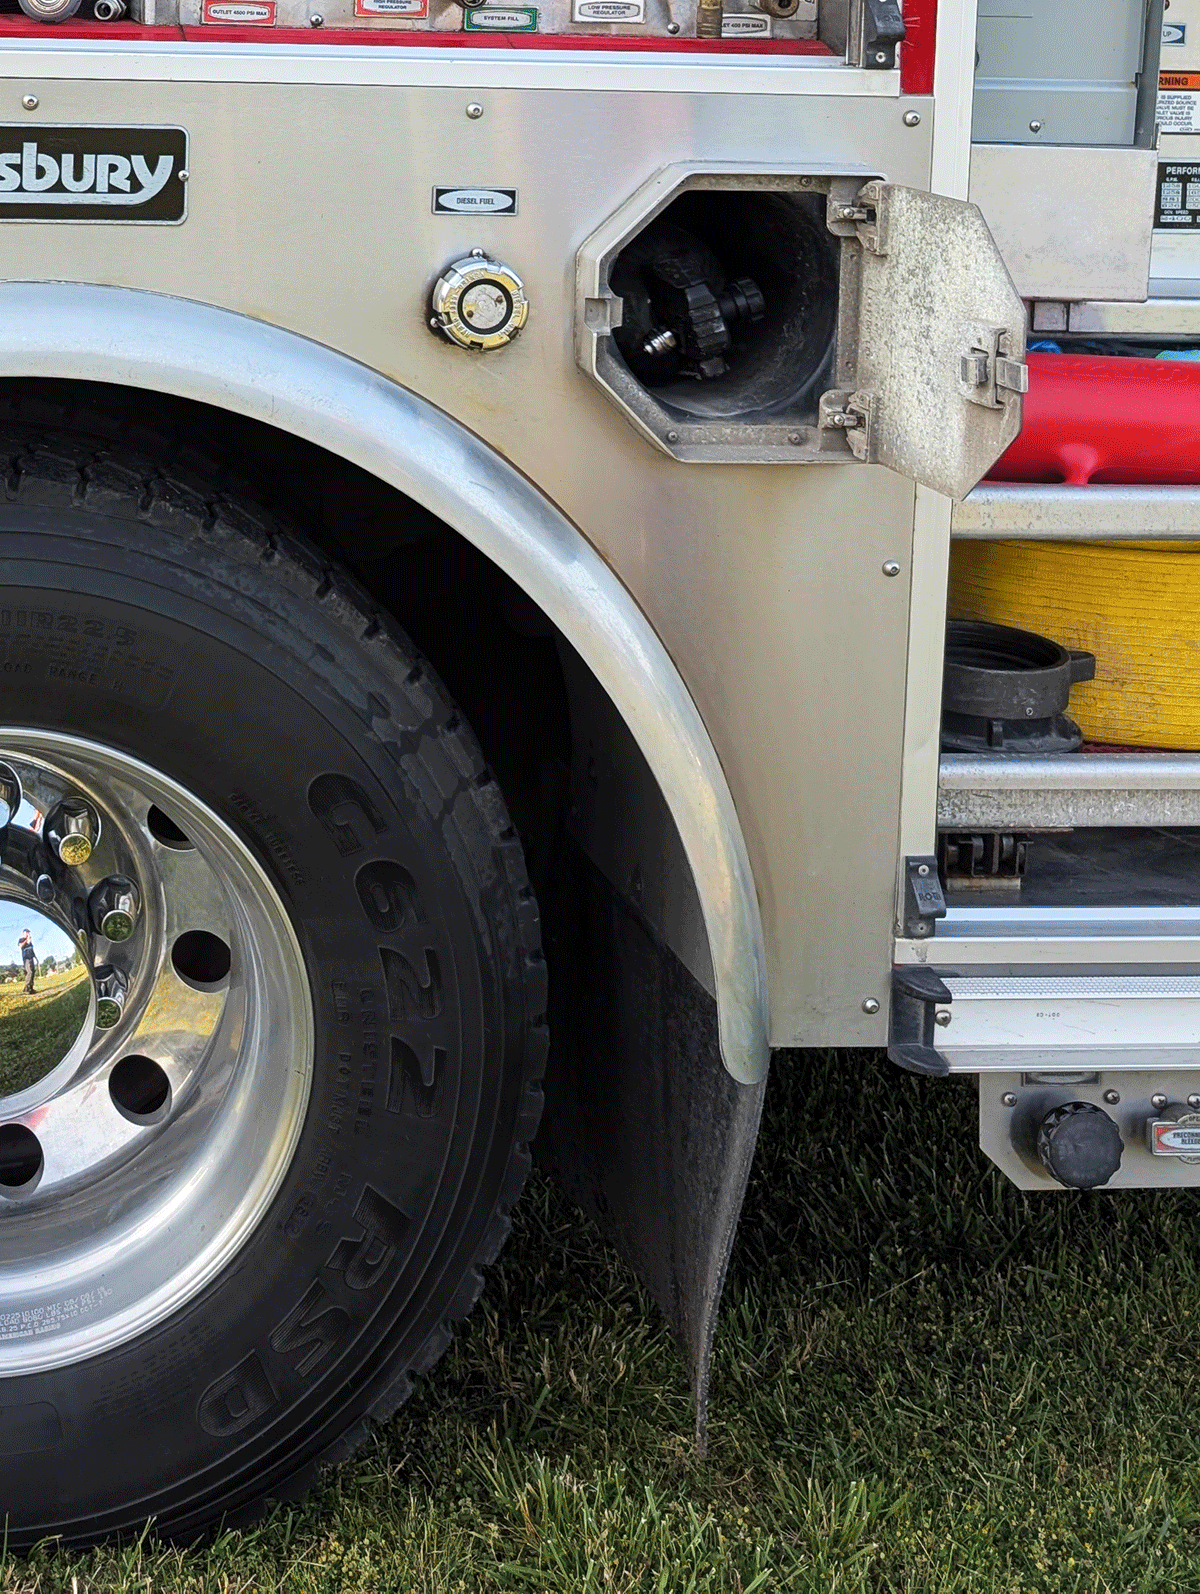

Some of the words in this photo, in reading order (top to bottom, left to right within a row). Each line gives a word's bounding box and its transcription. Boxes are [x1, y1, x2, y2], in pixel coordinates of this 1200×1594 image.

[1162, 30, 1172, 38] UP
[456, 197, 478, 205] DIESEL
[479, 197, 495, 205] FUEL
[48, 661, 99, 687] RANGE
[306, 771, 447, 1120] G622
[350, 984, 379, 1139] UNISTEEL
[0, 1318, 20, 1327] LOAD
[45, 1310, 62, 1318] LBS
[63, 1303, 79, 1312] MAX
[195, 1187, 412, 1438] RSD
